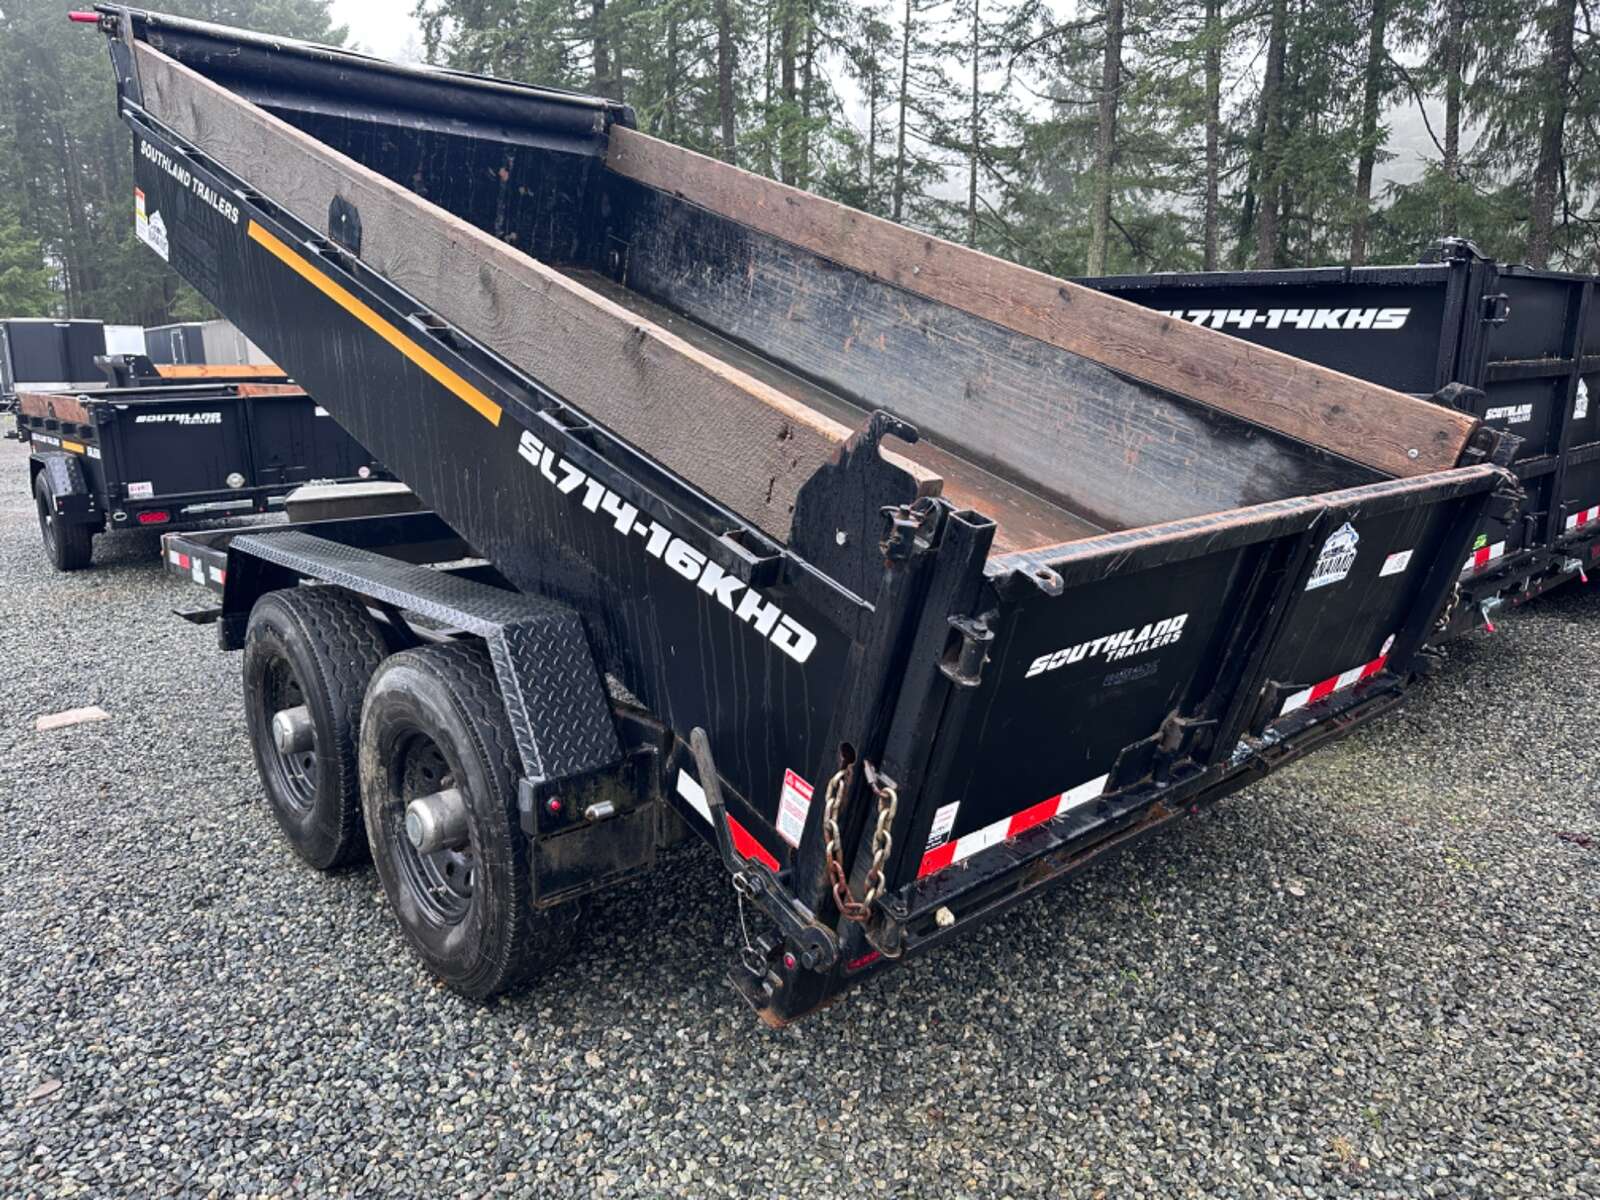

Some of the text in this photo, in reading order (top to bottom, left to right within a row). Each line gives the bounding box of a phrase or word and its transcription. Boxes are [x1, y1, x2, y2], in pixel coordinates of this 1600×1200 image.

[140, 139, 191, 187] SOUTHLAND
[192, 177, 239, 224] TRAILERS
[1157, 307, 1411, 329] 714-14KHS
[517, 429, 818, 663] SL714-16KHD
[1025, 613, 1189, 679] SOUTHLAND
[1105, 629, 1183, 663] TRAILERS
